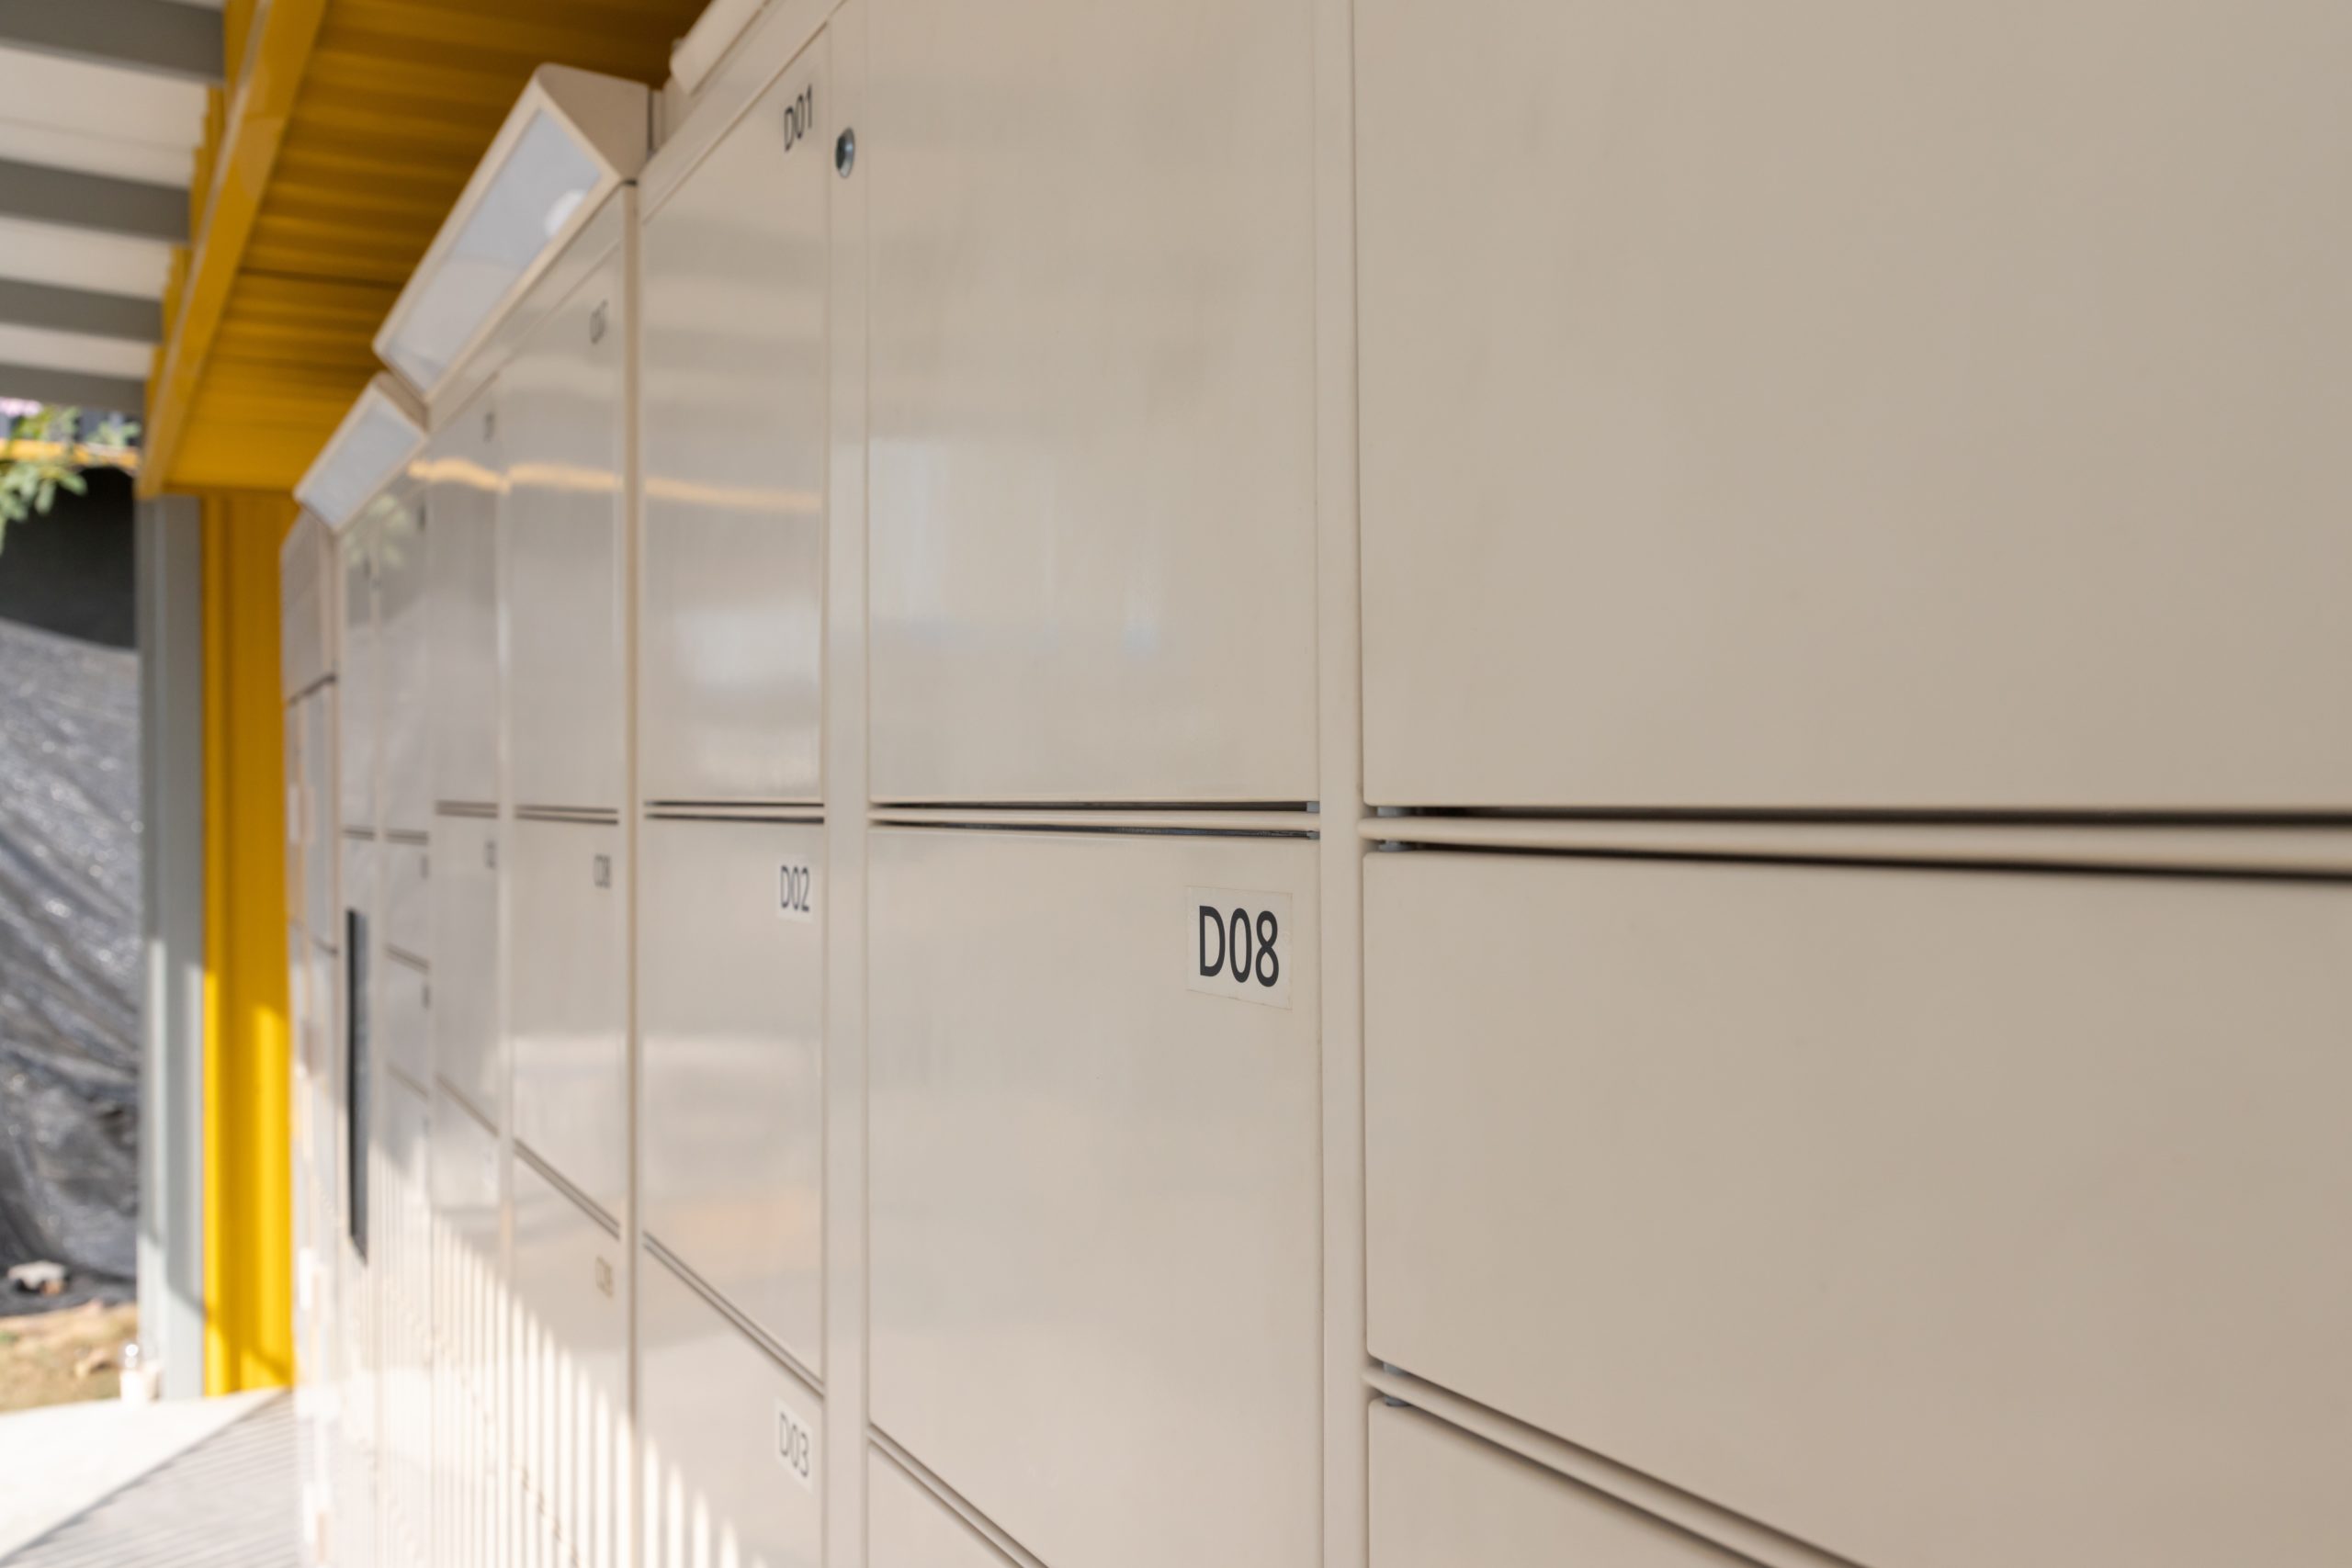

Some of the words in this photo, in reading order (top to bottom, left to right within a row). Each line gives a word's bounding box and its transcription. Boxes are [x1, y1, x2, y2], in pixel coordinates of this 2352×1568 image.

[784, 84, 812, 151] D01
[780, 865, 809, 911] D02
[1199, 905, 1279, 987] D08
[779, 1413, 808, 1478] D03
